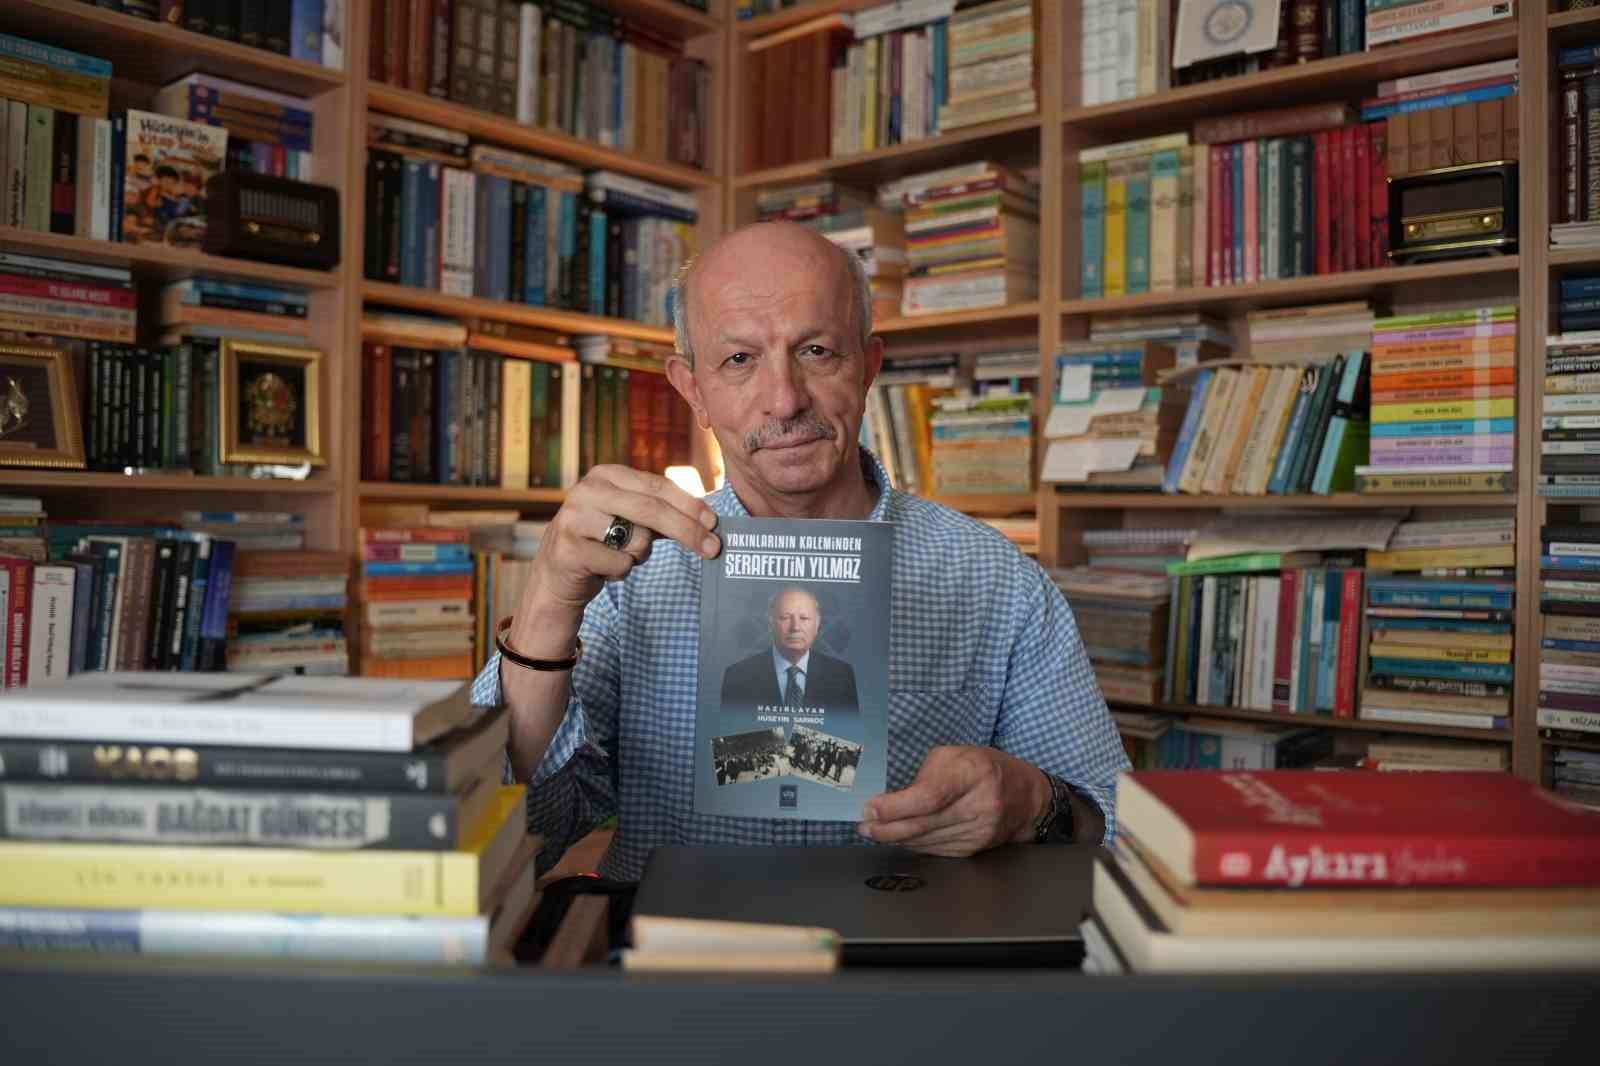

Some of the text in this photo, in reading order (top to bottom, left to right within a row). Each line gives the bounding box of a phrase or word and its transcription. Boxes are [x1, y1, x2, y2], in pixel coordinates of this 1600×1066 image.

[727, 533, 862, 551] YAKINLARININ KALEMİNDEN
[725, 553, 861, 579] ŞERAFETTİN YILMAZ
[757, 705, 825, 714] HAZIRLAYAN
